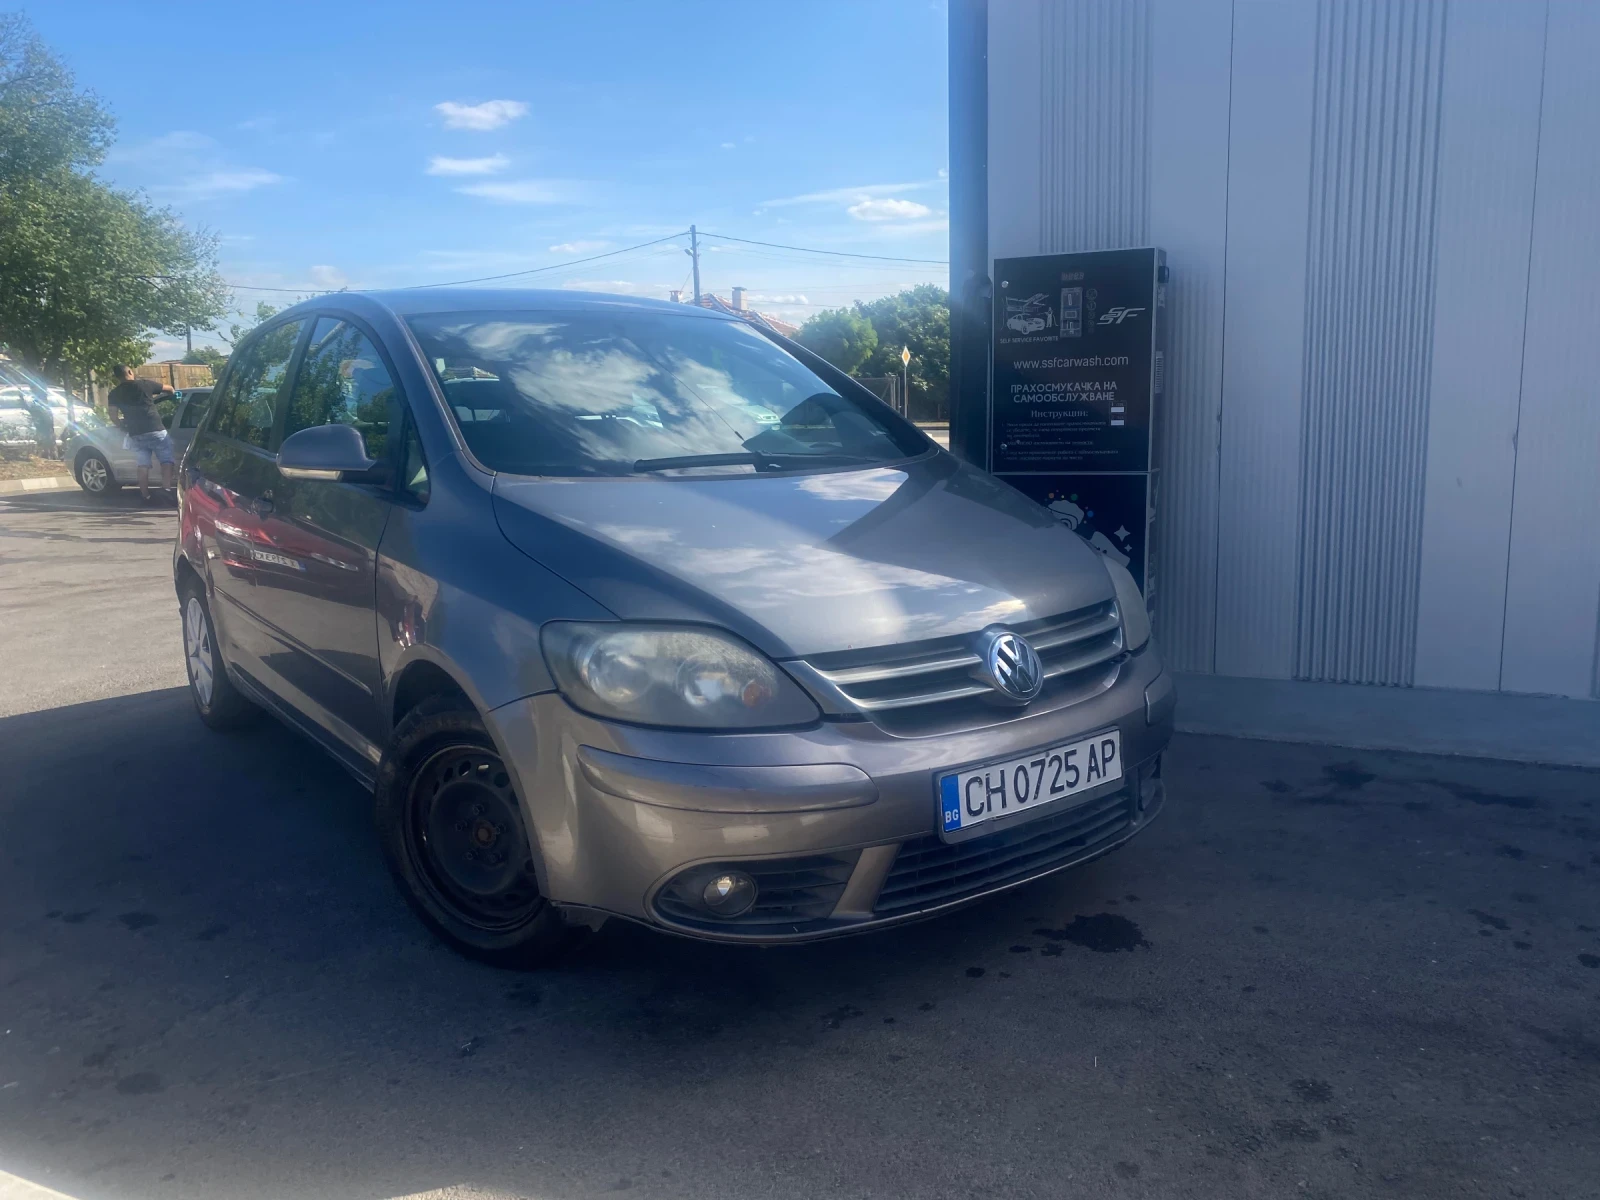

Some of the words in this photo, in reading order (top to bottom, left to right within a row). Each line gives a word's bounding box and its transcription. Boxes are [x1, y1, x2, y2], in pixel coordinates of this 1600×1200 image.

[1013, 355, 1129, 370] www.ssfcarwash.com
[1010, 382, 1101, 394] ПРАХОСМУКАЧКА
[1103, 381, 1118, 391] НА
[1013, 391, 1115, 403] САМООБСЛУЖВАНЕ
[965, 769, 1007, 817] CH
[1013, 749, 1080, 804] 0725
[1086, 738, 1116, 783] AP
[944, 808, 959, 824] BG
